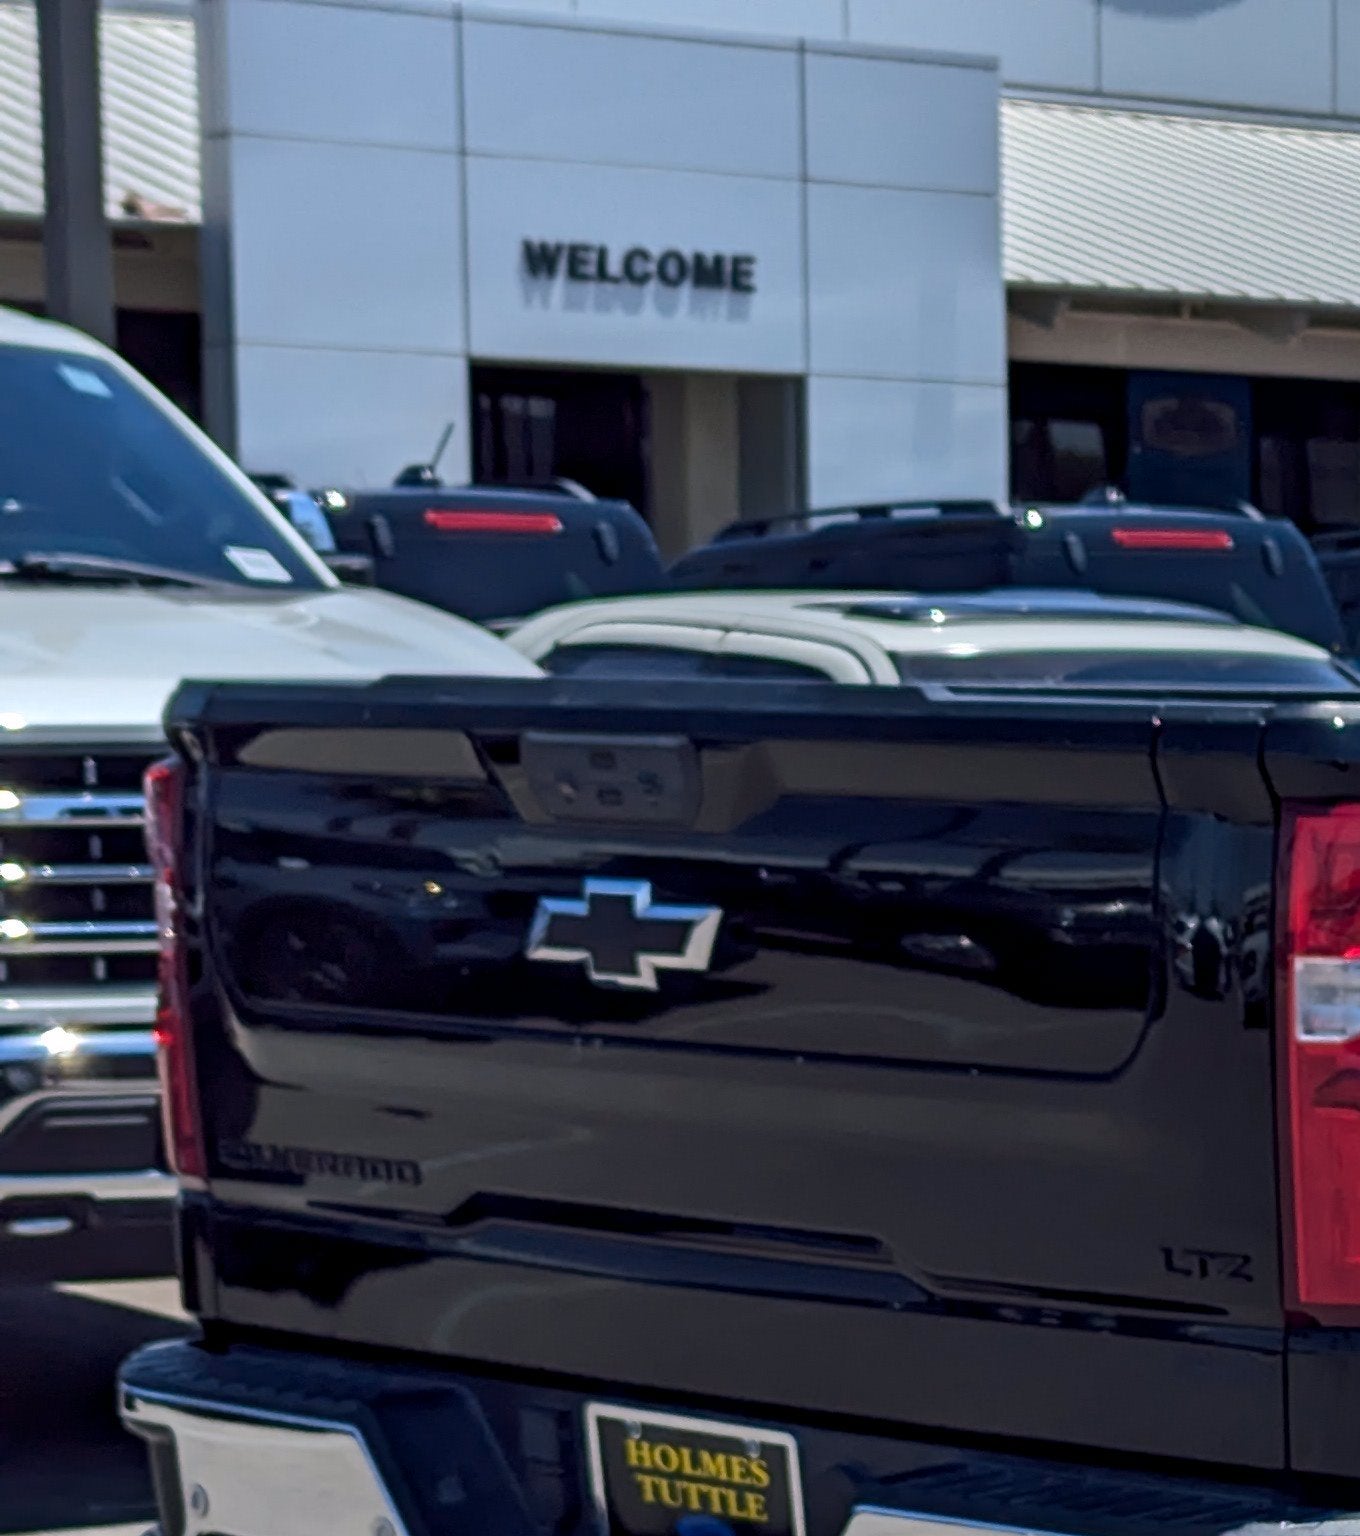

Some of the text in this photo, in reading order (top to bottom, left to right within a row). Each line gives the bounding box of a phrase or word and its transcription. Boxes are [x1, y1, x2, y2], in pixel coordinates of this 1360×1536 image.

[521, 238, 757, 293] WELCOME
[1160, 1246, 1253, 1282] LTZ
[626, 1438, 770, 1488] HOLMES
[634, 1473, 769, 1523] TUTTLE
